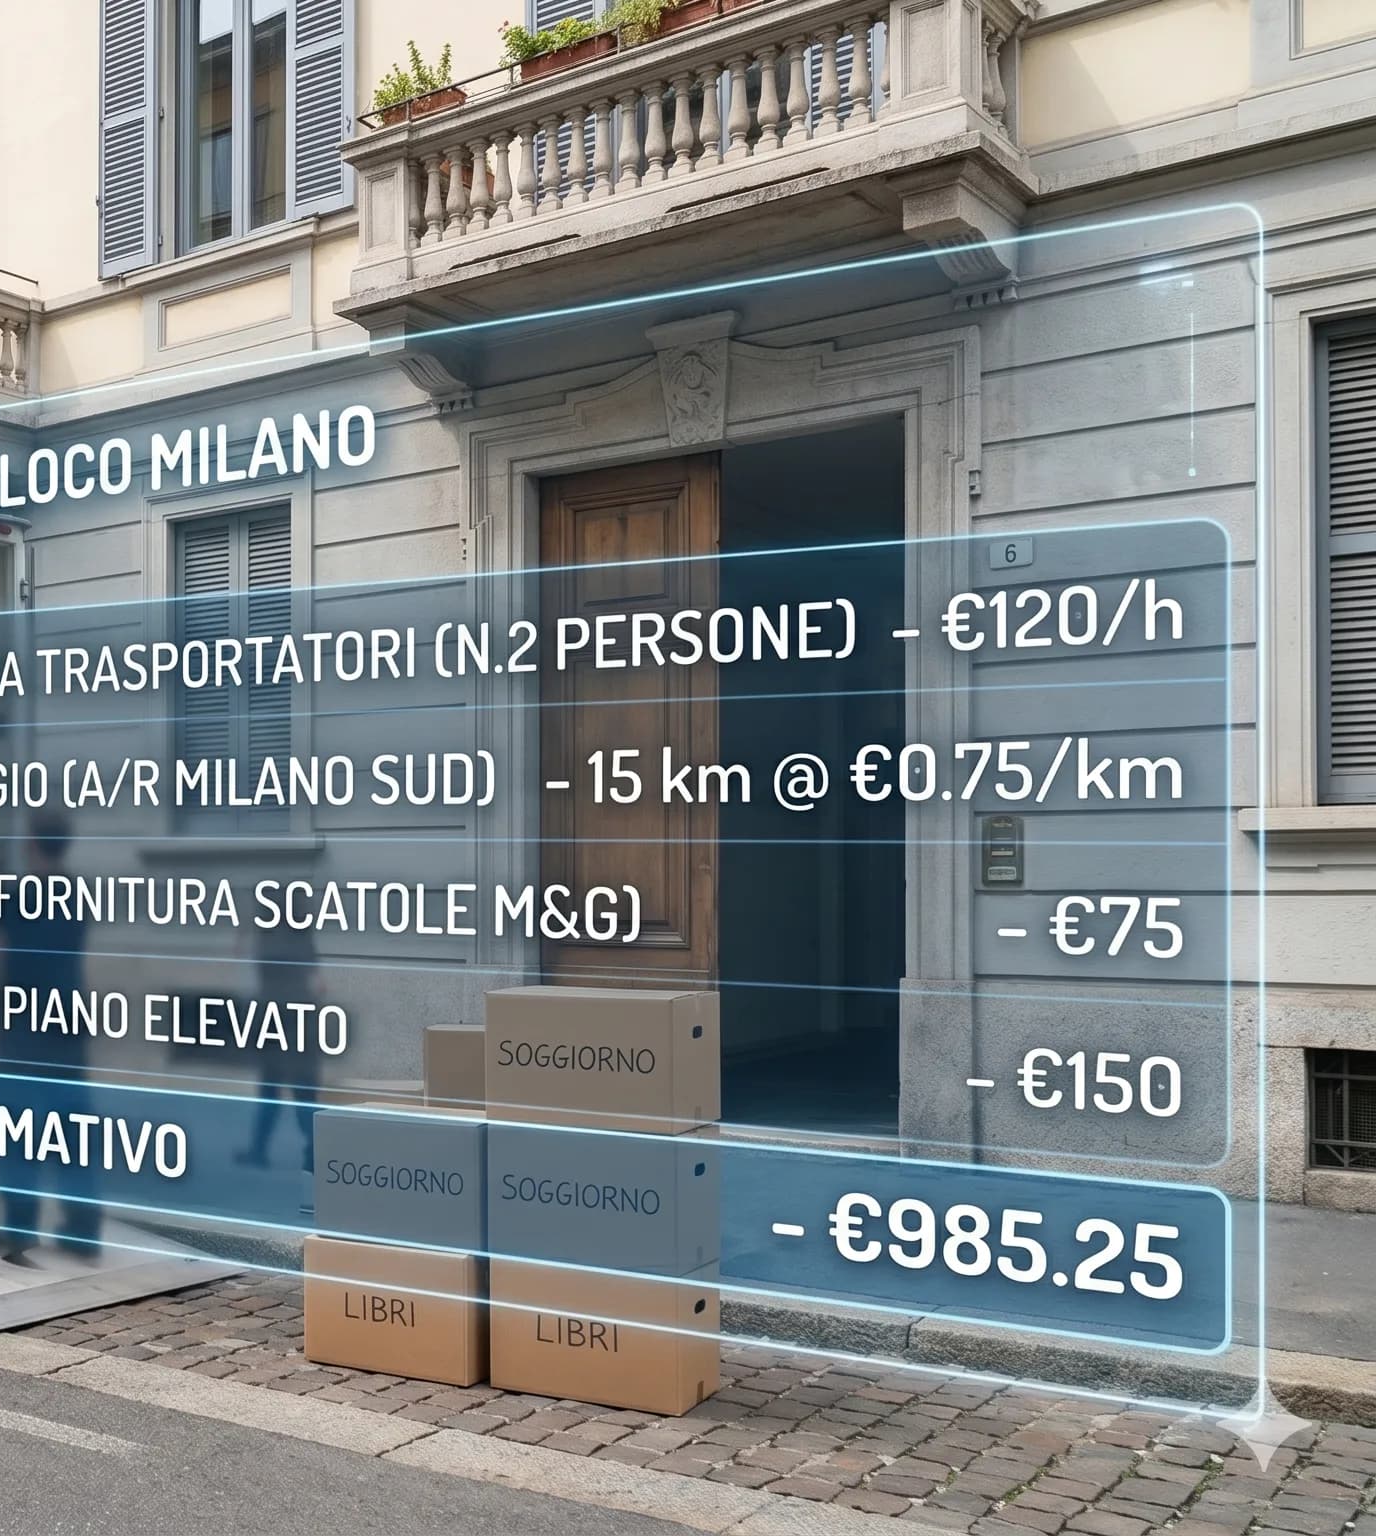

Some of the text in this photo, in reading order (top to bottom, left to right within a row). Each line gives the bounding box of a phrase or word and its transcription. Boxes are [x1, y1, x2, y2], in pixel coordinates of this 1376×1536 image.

[1005, 544, 1016, 563] 6
[497, 1040, 656, 1074] SOGGIORNO
[326, 1159, 464, 1196] SOGGIORNO
[501, 1174, 661, 1216] SOGGIORNO
[344, 1291, 416, 1328] LIBRI
[536, 1314, 619, 1353] LIBRI
